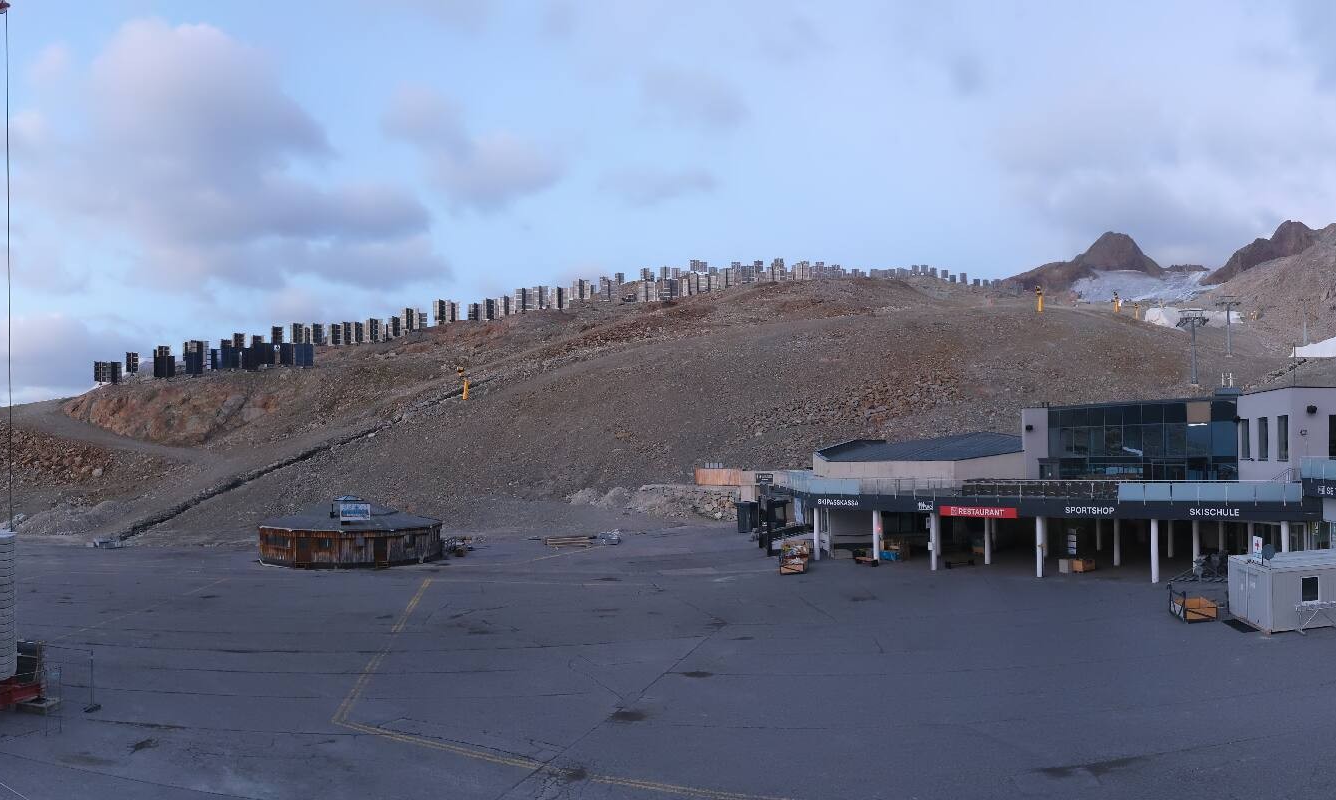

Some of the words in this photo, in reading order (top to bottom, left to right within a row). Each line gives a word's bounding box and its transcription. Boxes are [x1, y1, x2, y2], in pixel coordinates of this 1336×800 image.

[958, 508, 1005, 517] RESTAURANT
[1065, 506, 1115, 515] SPORTSHOP
[1189, 508, 1240, 517] SKISCHULE
